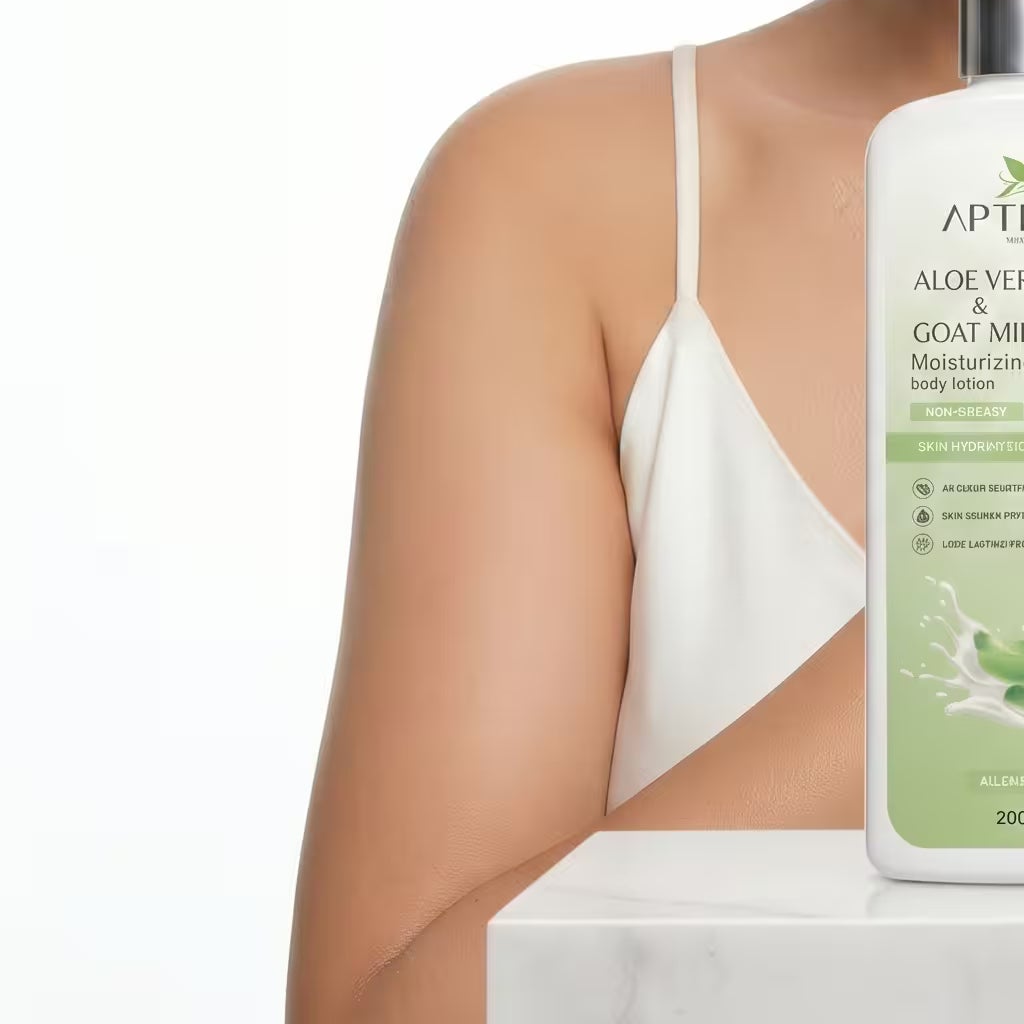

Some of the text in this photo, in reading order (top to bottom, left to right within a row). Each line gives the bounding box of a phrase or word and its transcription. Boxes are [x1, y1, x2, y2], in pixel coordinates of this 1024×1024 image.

[913, 269, 979, 291] ALOE
[972, 296, 989, 315] &
[913, 321, 981, 343] GOAT
[911, 377, 995, 393] body lotion
[918, 441, 948, 452] SKIN
[942, 511, 963, 520] SKIN
